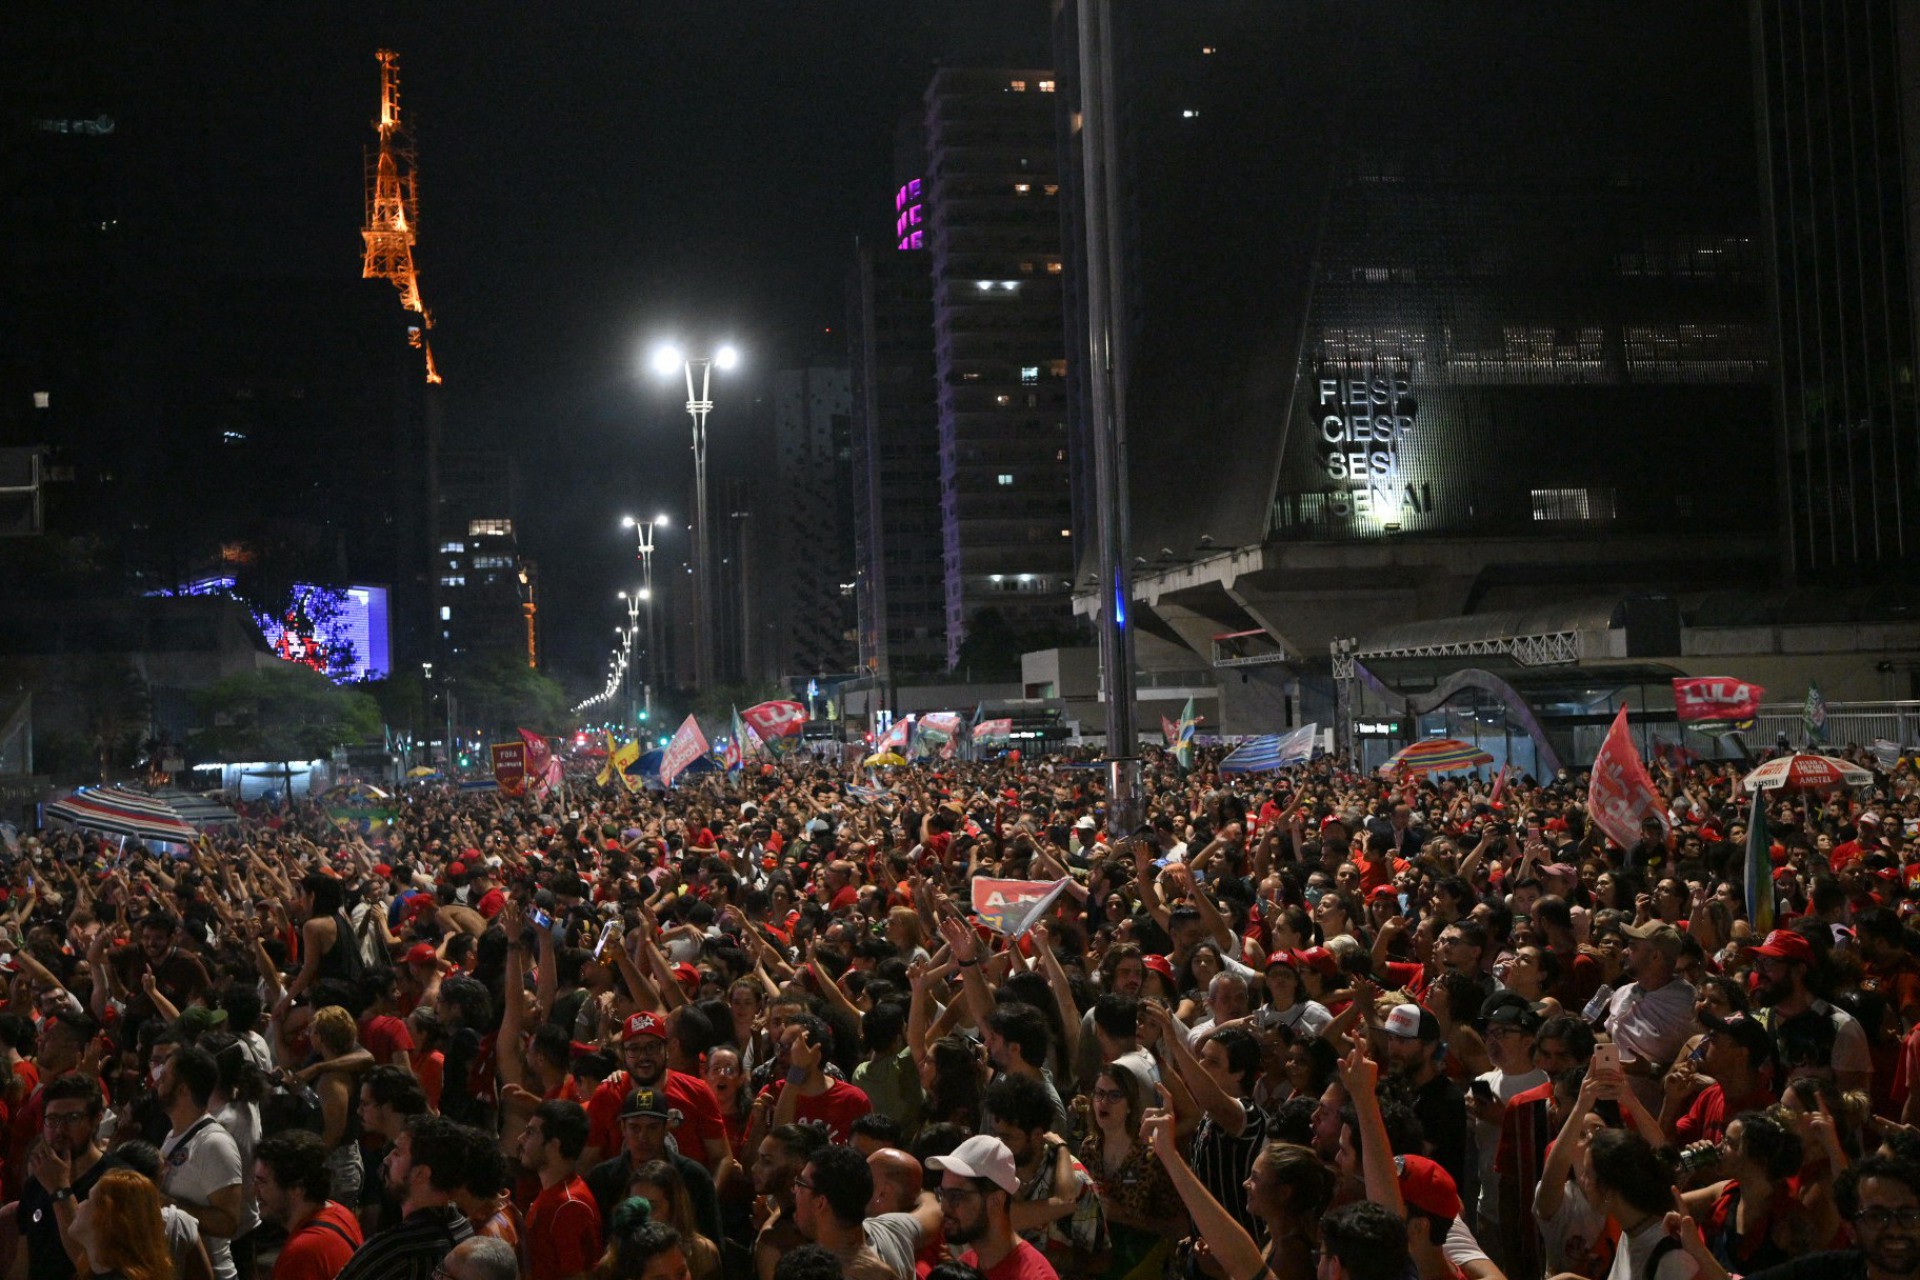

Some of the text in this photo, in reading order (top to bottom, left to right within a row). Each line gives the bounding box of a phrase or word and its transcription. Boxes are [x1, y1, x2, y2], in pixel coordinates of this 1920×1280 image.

[1319, 379, 1411, 405] FIESP
[1322, 415, 1415, 442] CIESP
[1327, 452, 1398, 479] SESI
[1330, 483, 1432, 516] SENAI
[1683, 683, 1752, 704] LULA
[1753, 779, 1778, 788] AMSTEL
[1799, 776, 1832, 784] AMSTEL
